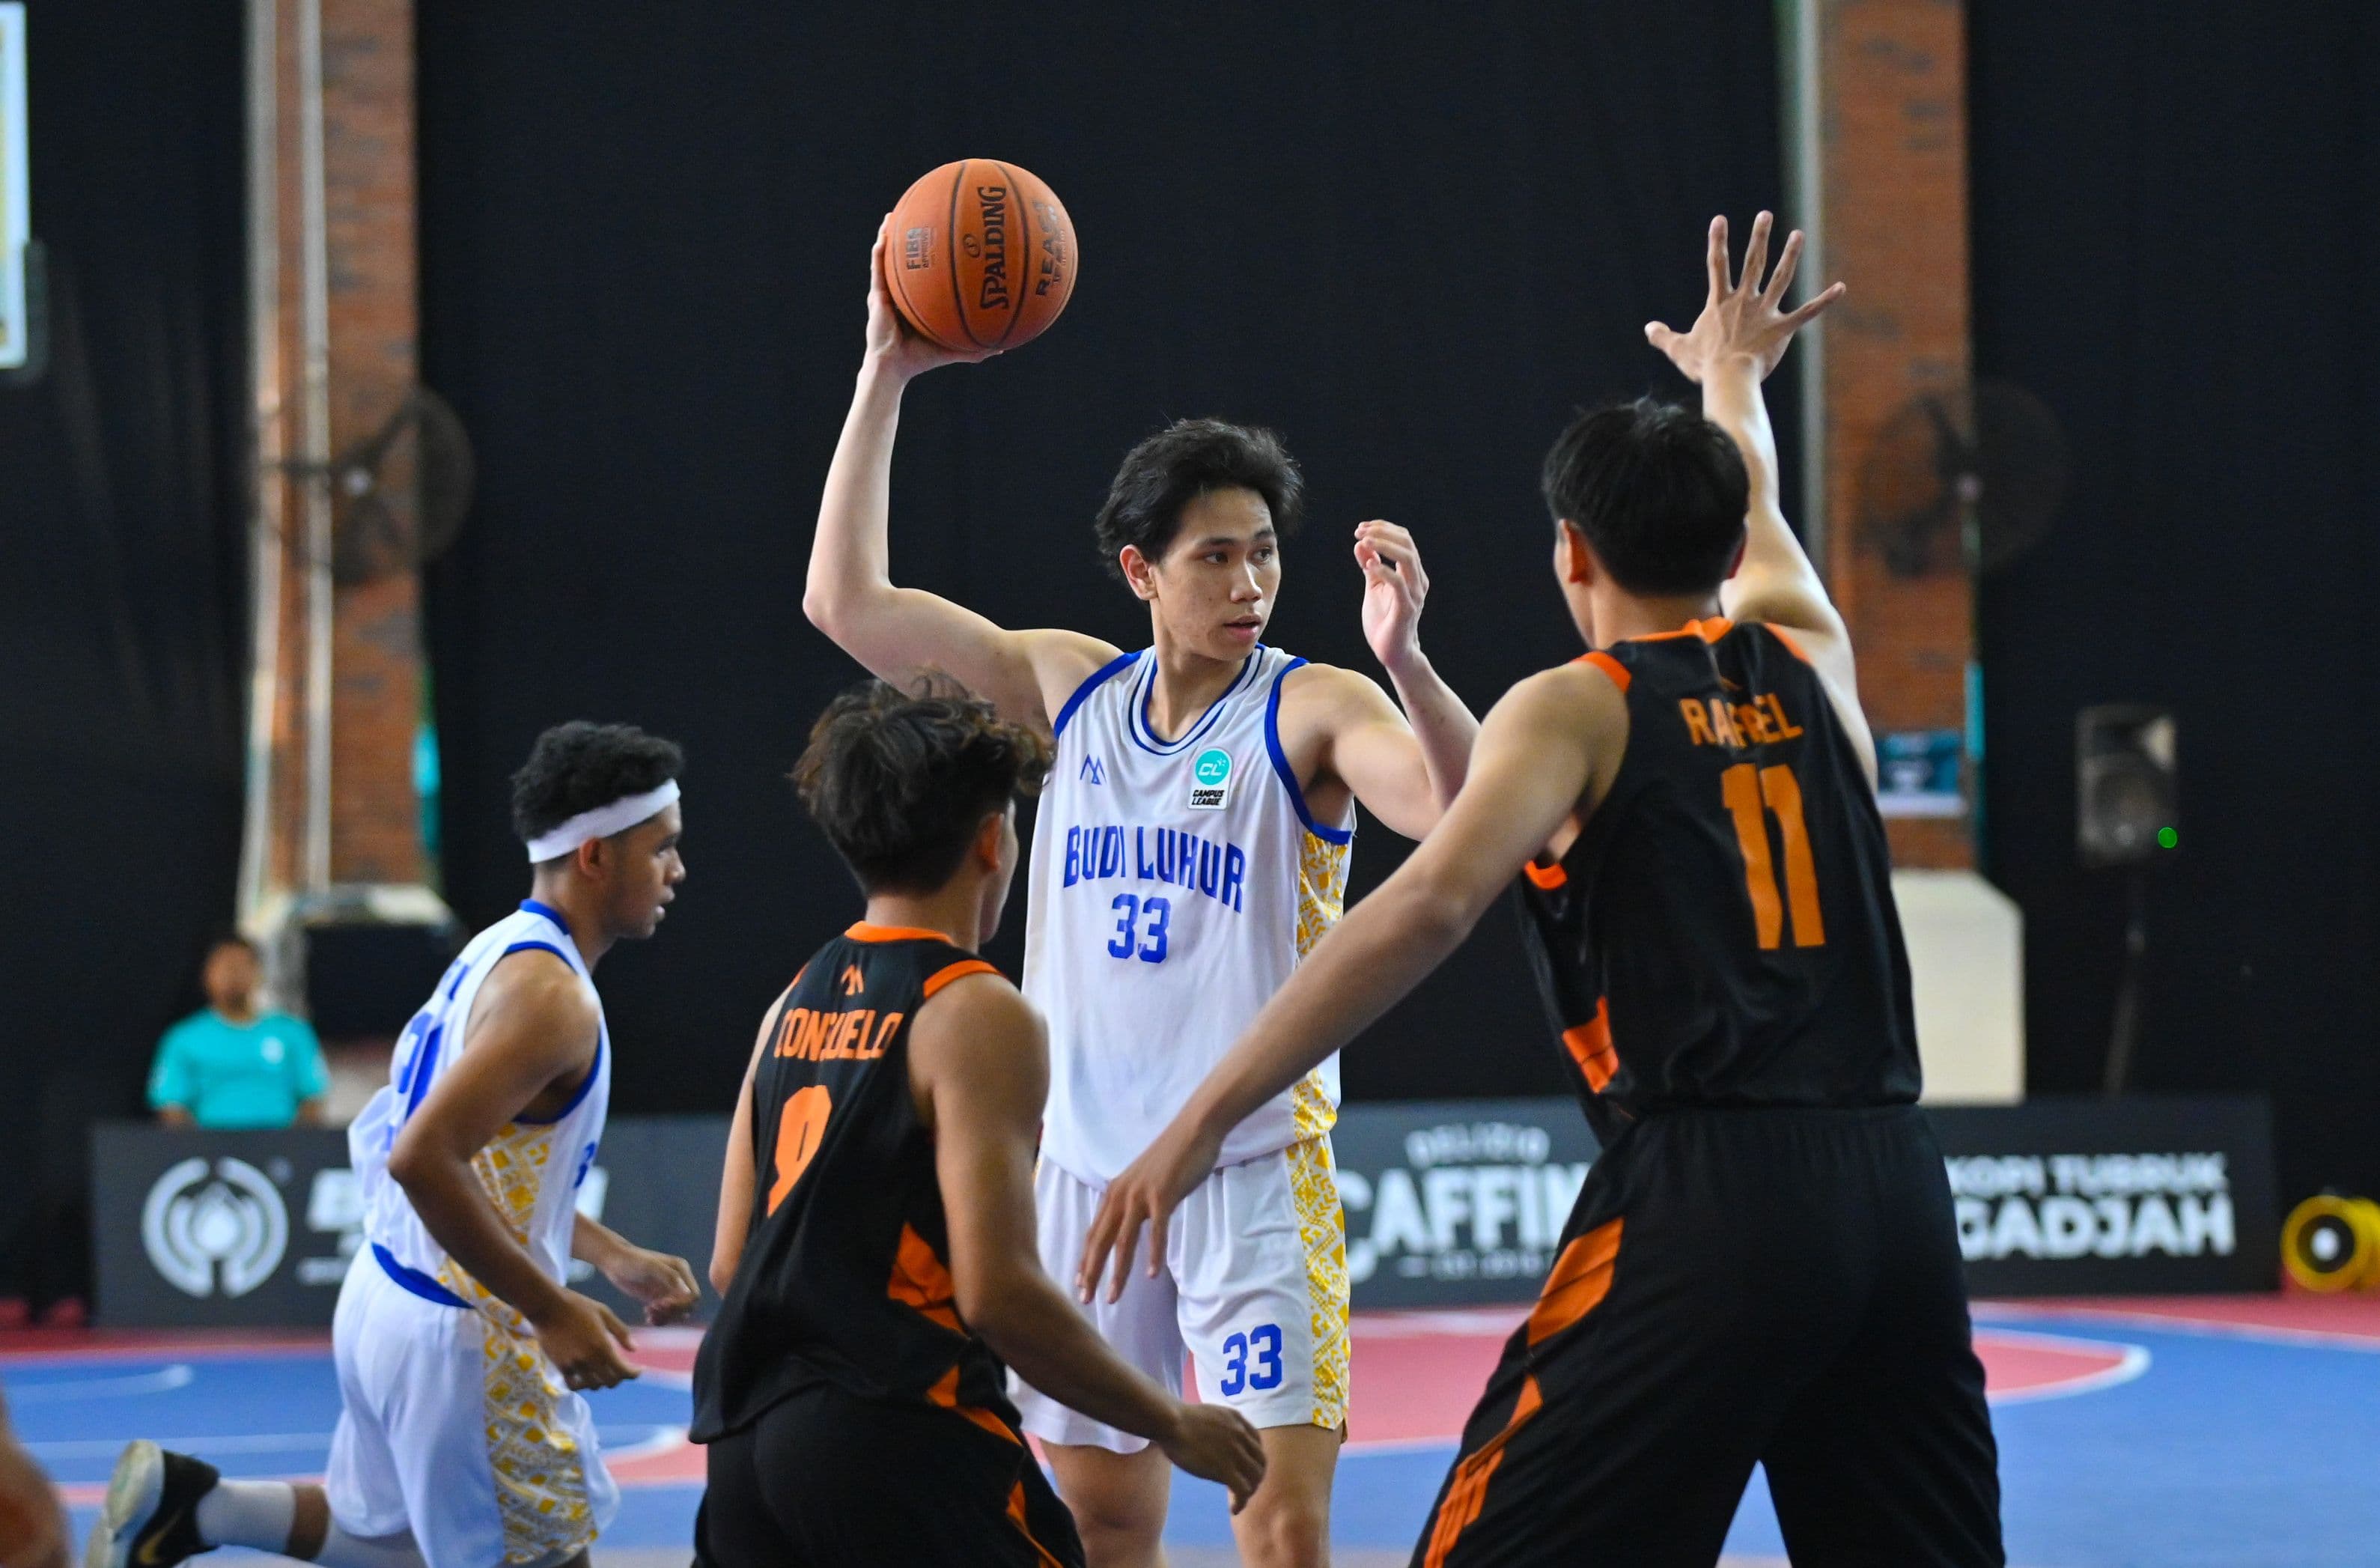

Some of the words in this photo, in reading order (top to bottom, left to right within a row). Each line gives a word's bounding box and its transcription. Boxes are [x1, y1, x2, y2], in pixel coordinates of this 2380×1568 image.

[978, 186, 1008, 310] SPALDING
[1192, 797, 1222, 806] LEAGUE
[1193, 789, 1225, 797] CAMPUS
[1063, 824, 1125, 888] BUDI
[1136, 826, 1247, 914] LUHUR
[1721, 762, 1826, 949] 11
[1107, 893, 1172, 964] 33
[1954, 1194, 2237, 1262] GADJAH
[1220, 1323, 1282, 1397] 33
